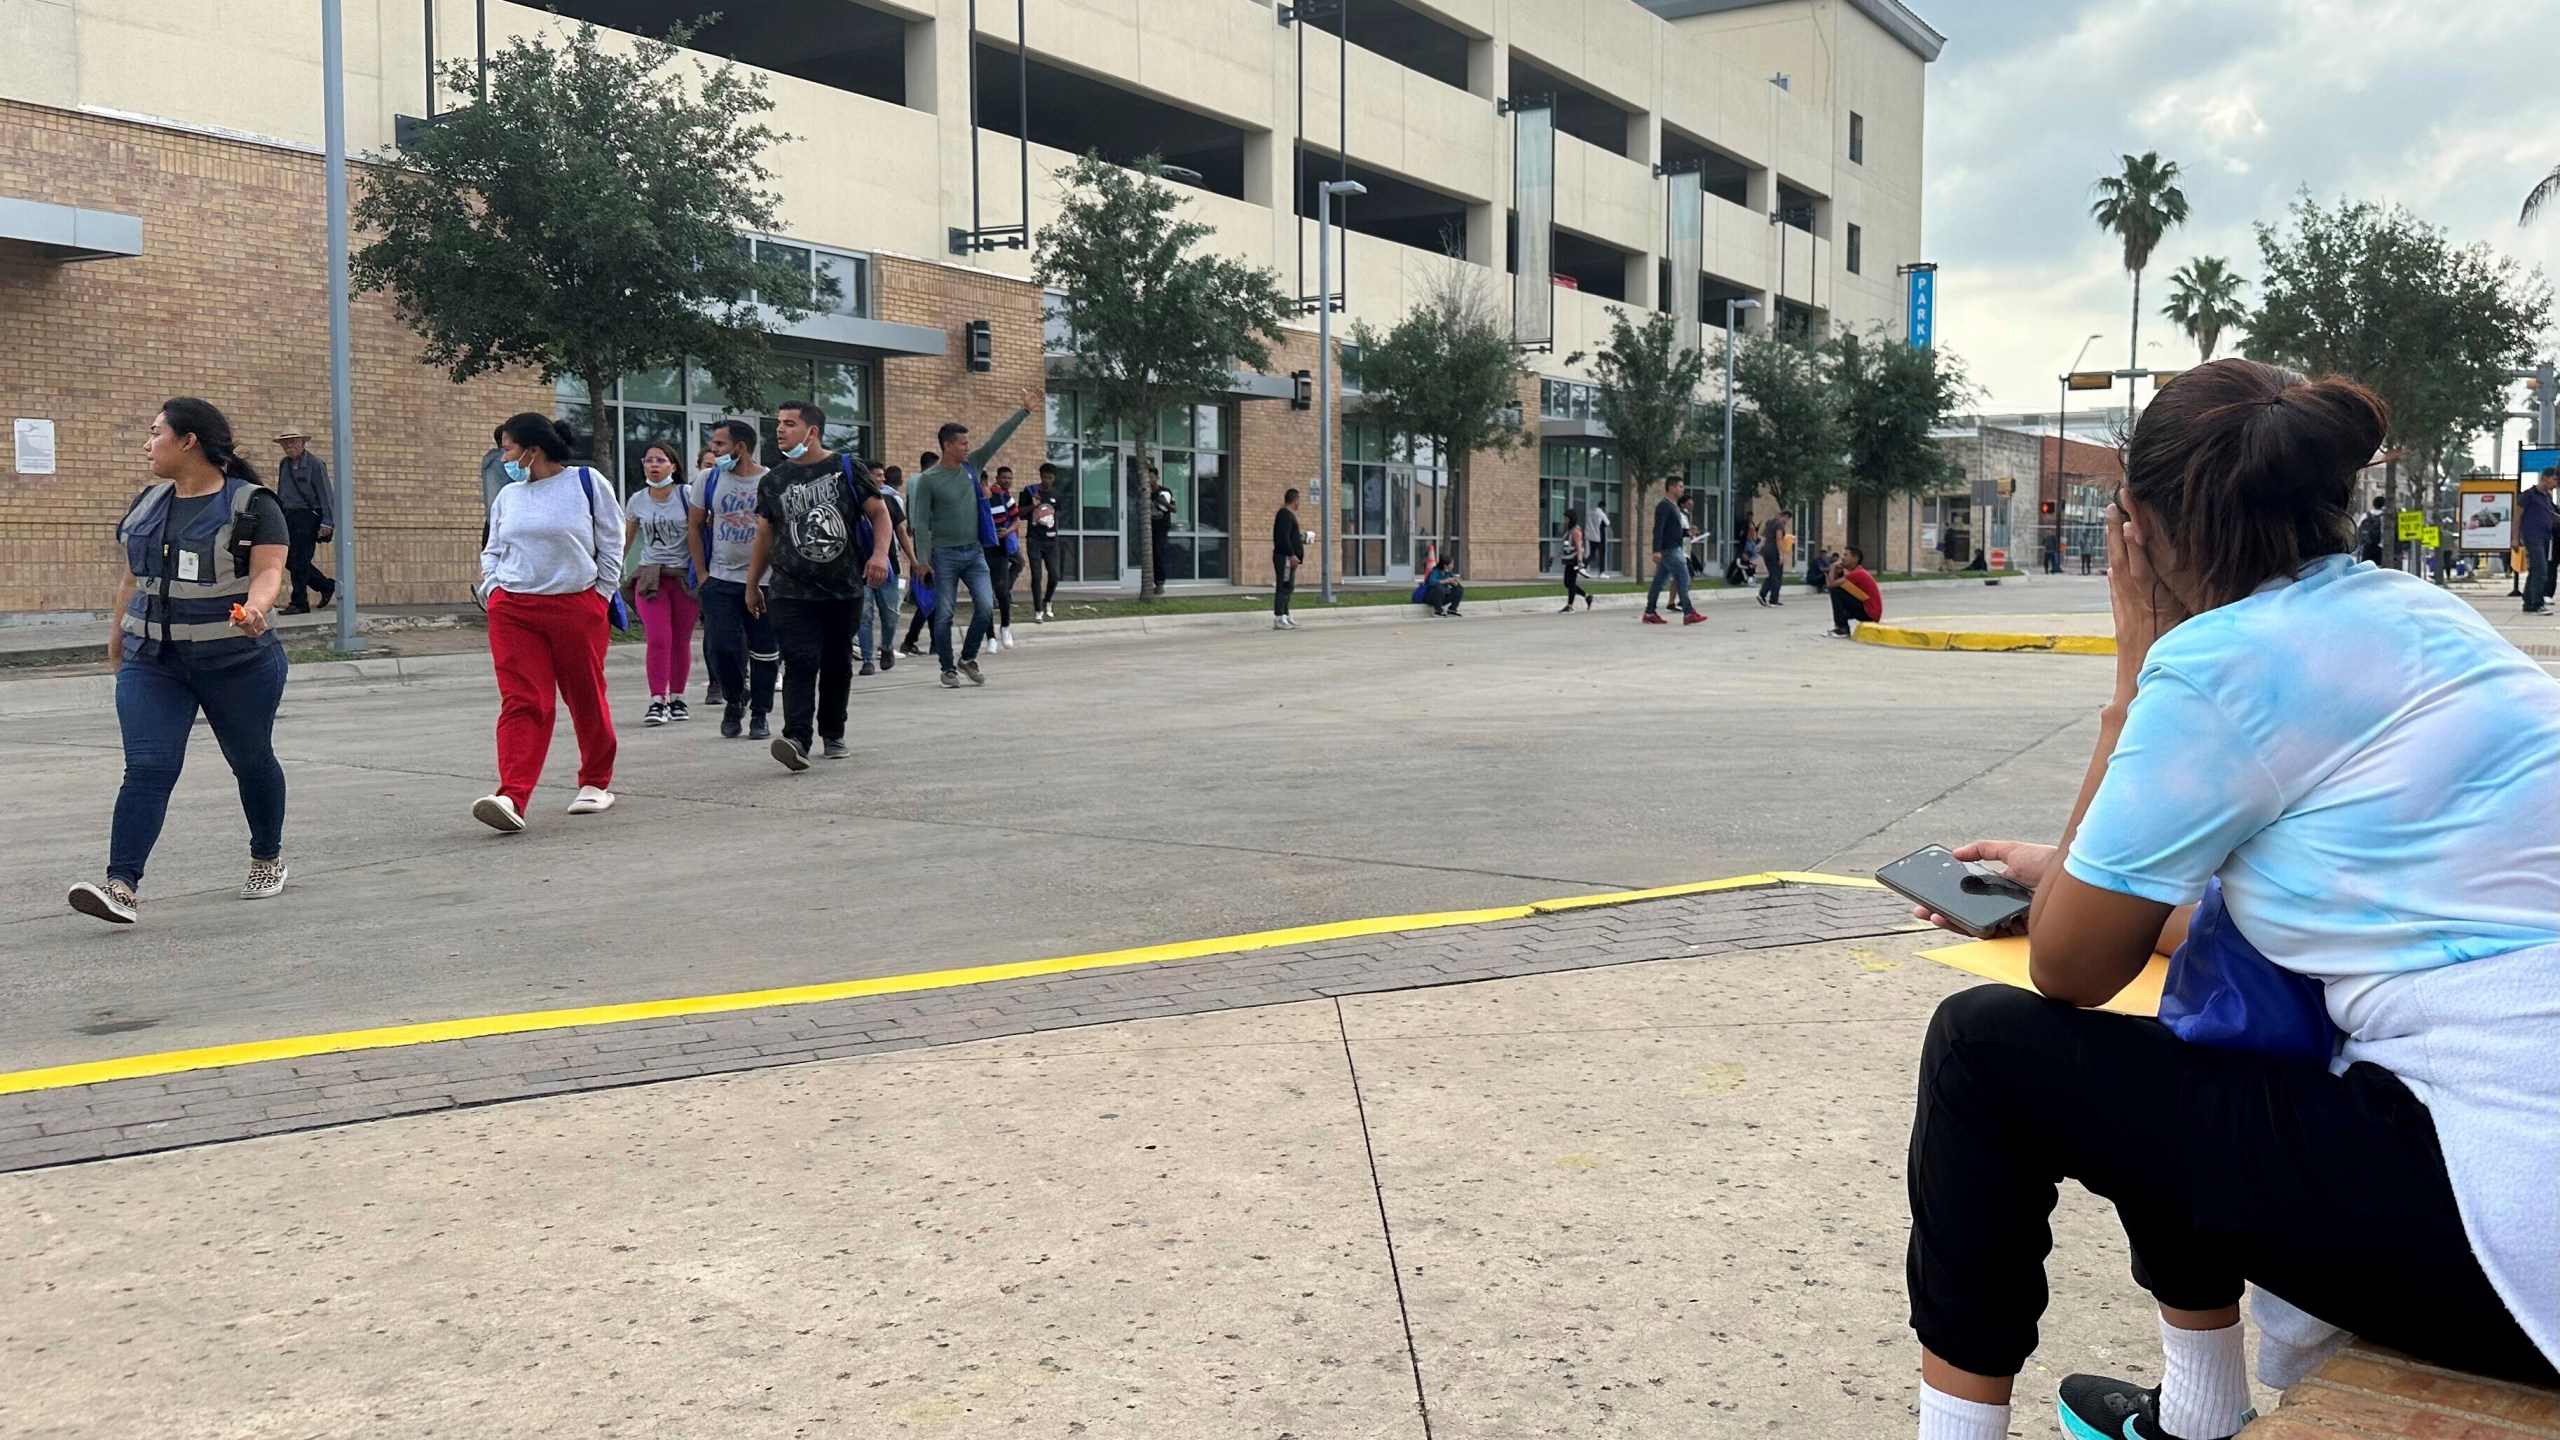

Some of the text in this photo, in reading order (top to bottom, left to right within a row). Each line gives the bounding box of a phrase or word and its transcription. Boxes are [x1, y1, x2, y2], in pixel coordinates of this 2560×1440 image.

[720, 493, 757, 514] Star
[781, 480, 837, 523] EMPIRE
[717, 521, 756, 544] Strip
